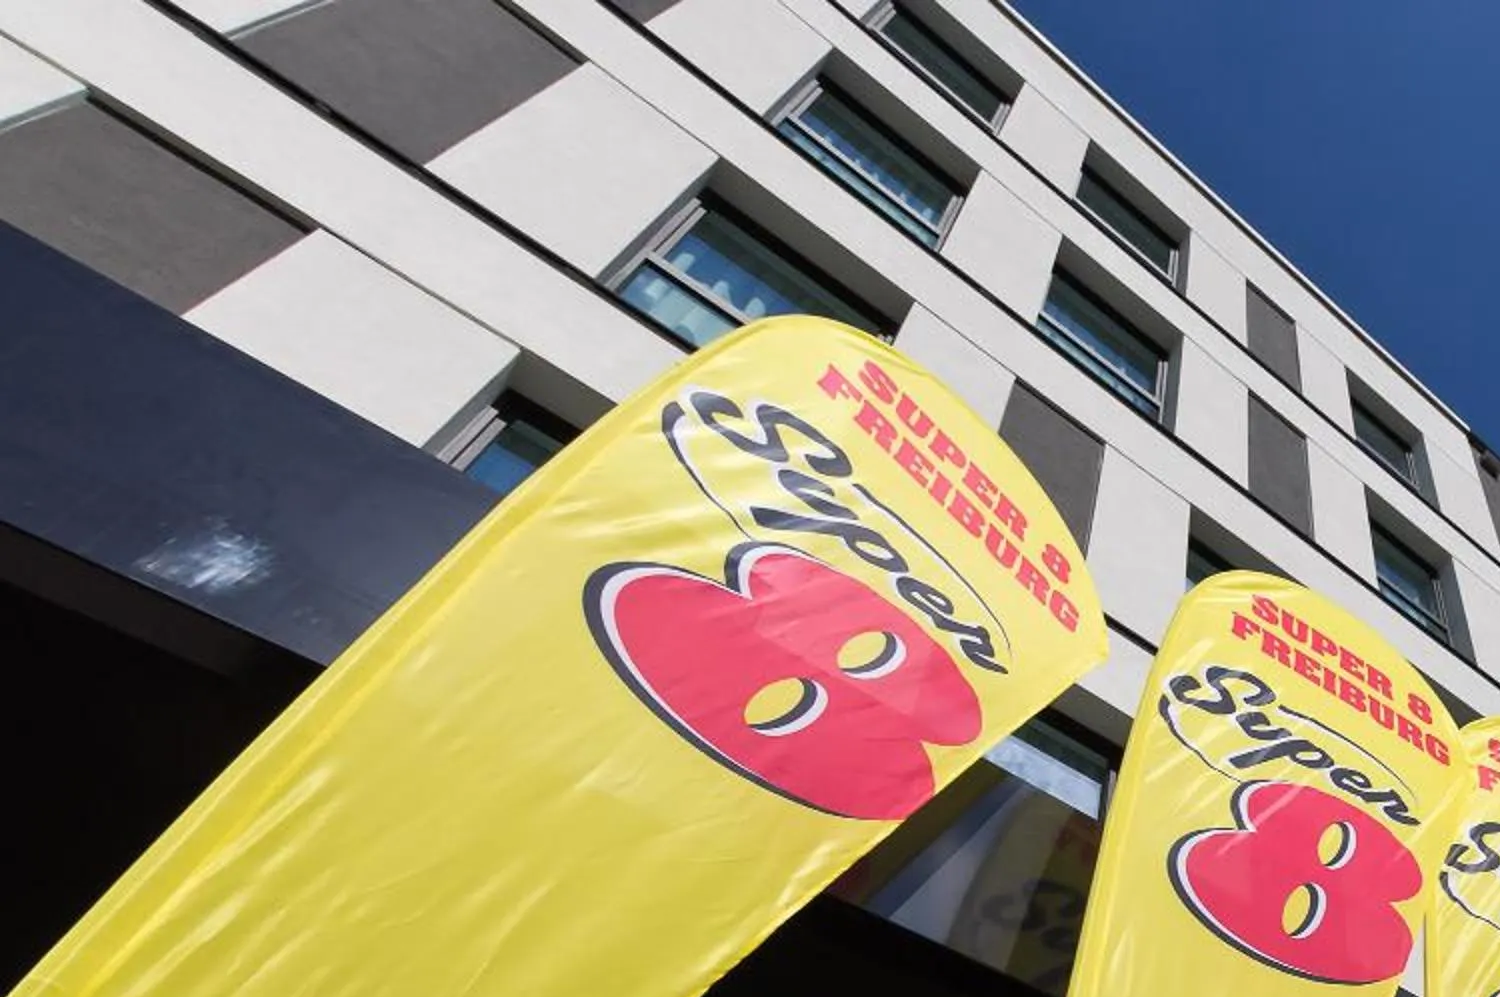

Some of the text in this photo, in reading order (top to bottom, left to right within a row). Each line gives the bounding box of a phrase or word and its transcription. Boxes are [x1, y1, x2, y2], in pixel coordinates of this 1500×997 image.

[664, 390, 1011, 675] Super
[817, 364, 1079, 632] FREIBURG
[859, 361, 1071, 585] SUPER 8
[582, 541, 983, 822] 8
[1162, 666, 1421, 826] Super
[1231, 611, 1450, 767] FREIBURG
[1252, 595, 1433, 726] SUPER 8
[1167, 780, 1424, 986] 8
